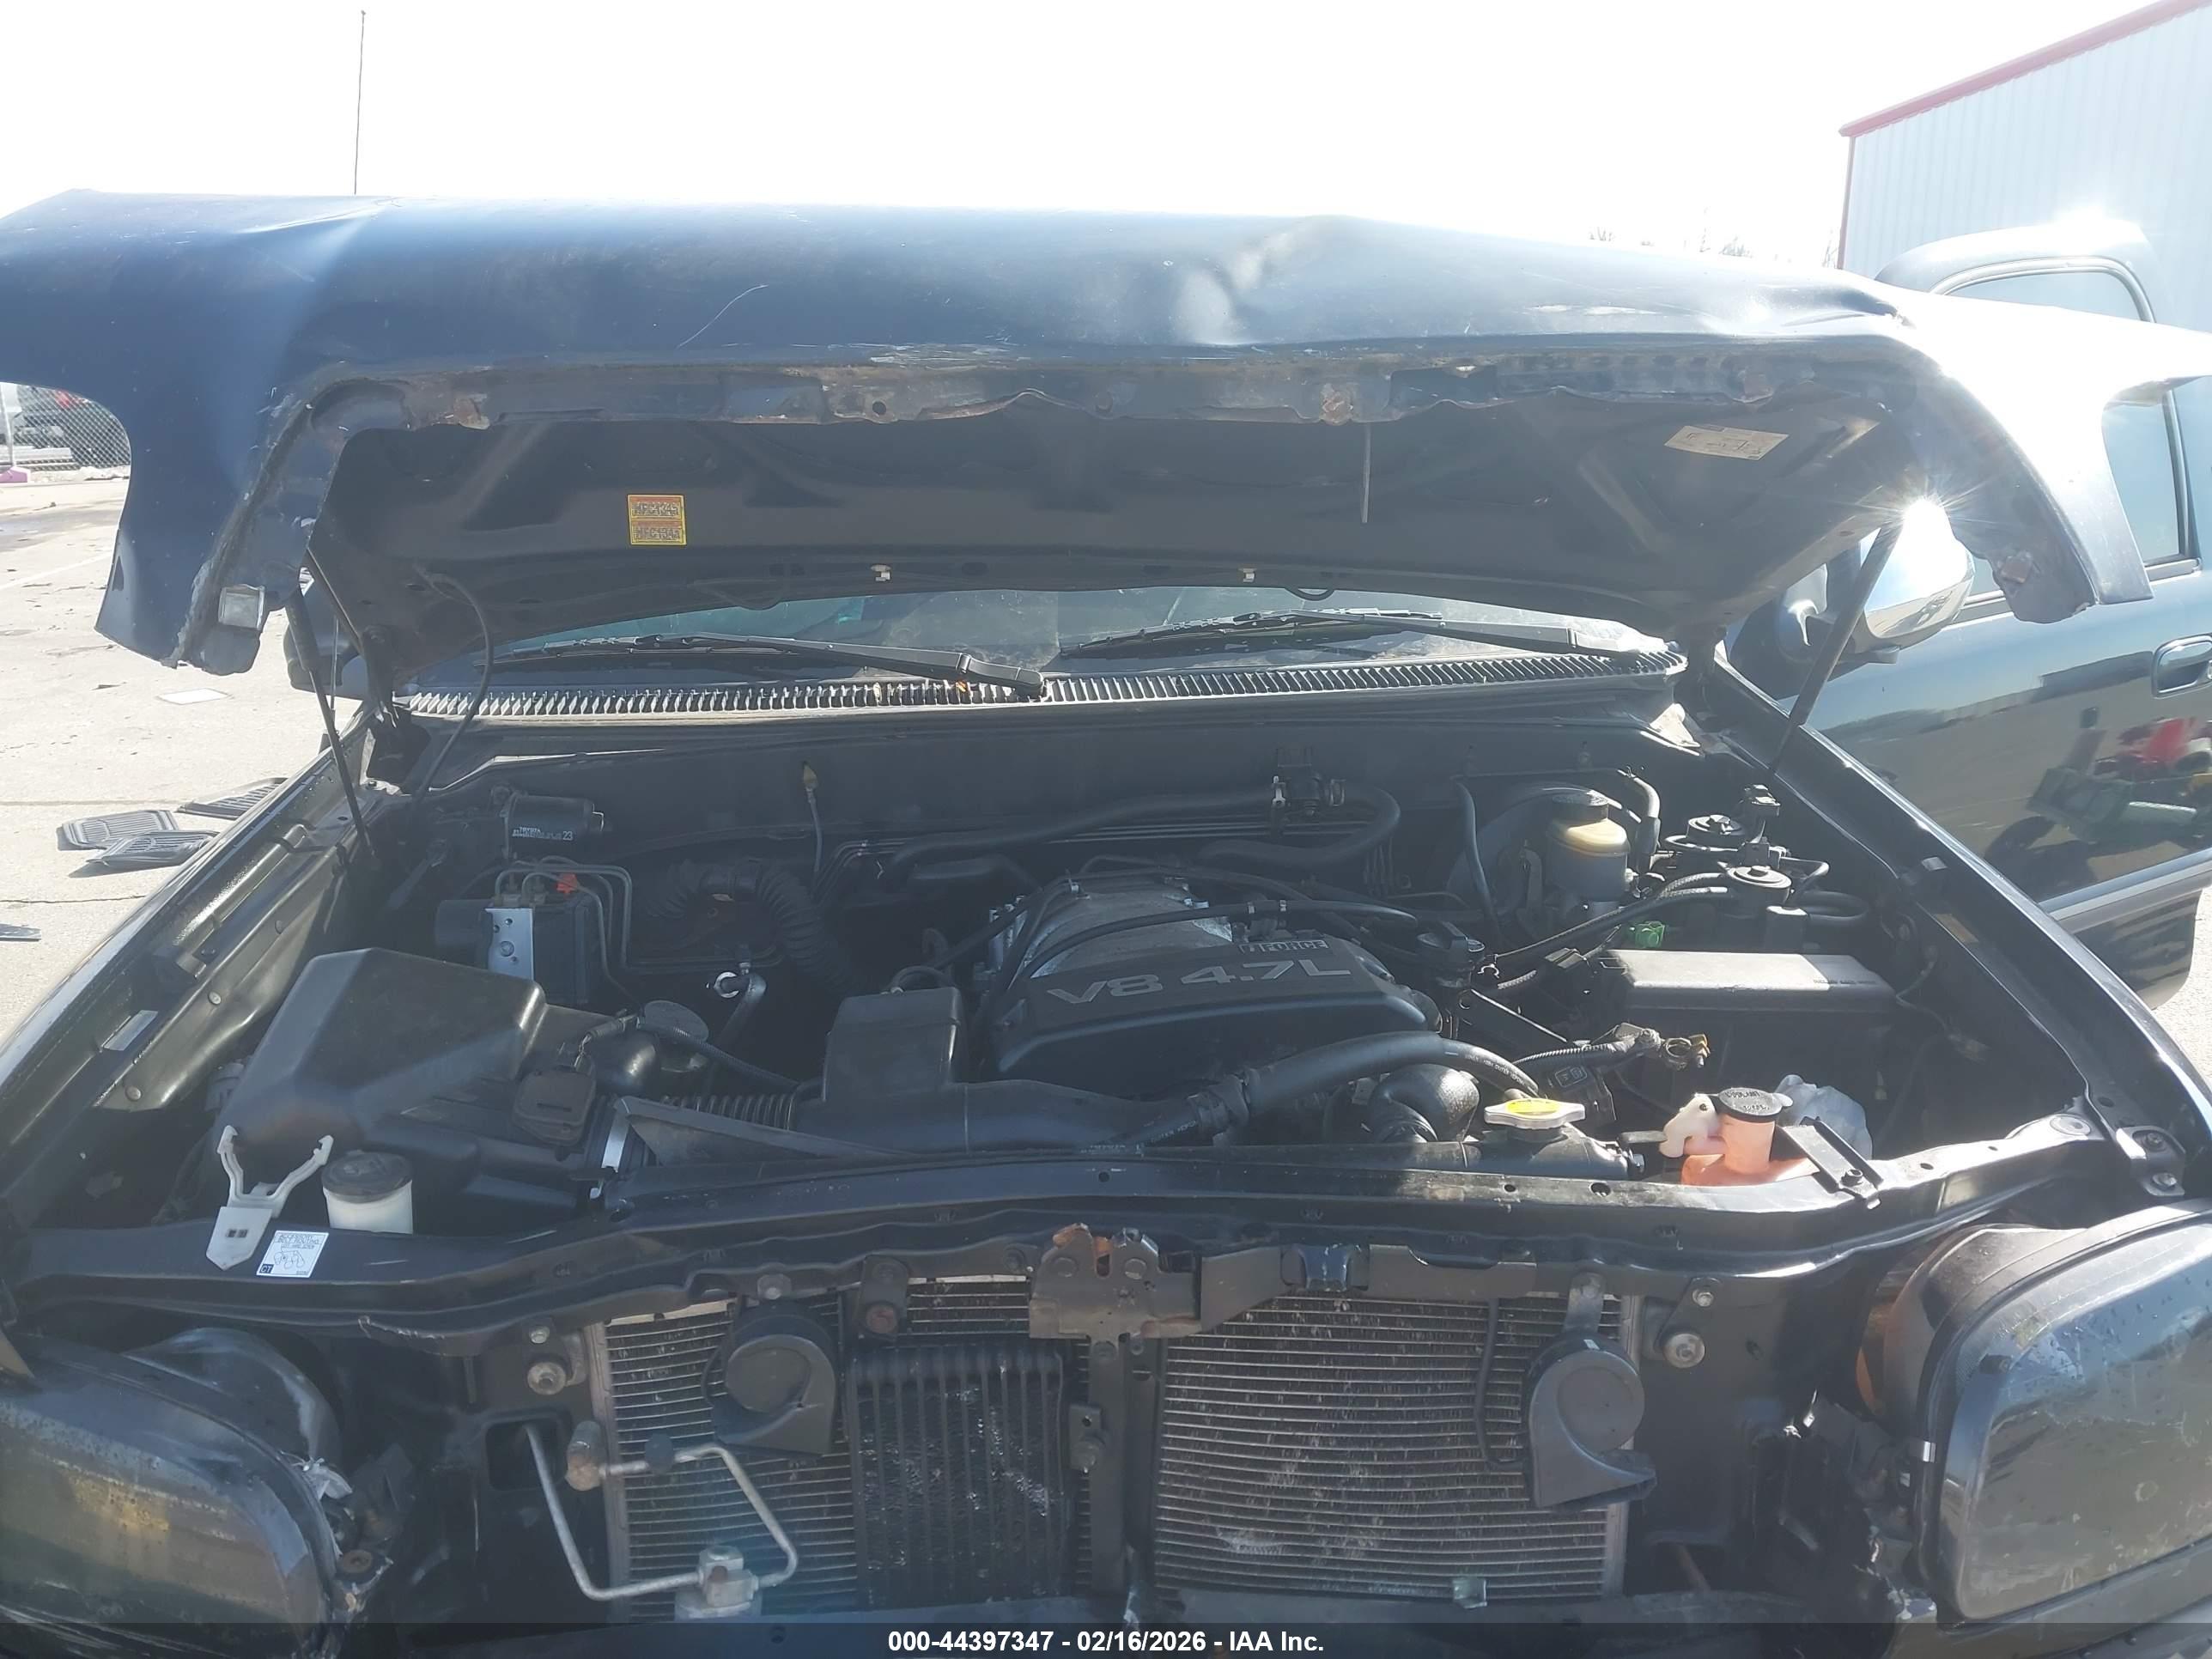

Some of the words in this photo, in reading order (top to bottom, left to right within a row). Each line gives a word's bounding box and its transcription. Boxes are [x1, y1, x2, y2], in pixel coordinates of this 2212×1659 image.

[1047, 974, 1164, 1005] V8
[1180, 959, 1352, 984] 4.7L
[259, 1265, 272, 1273] CT
